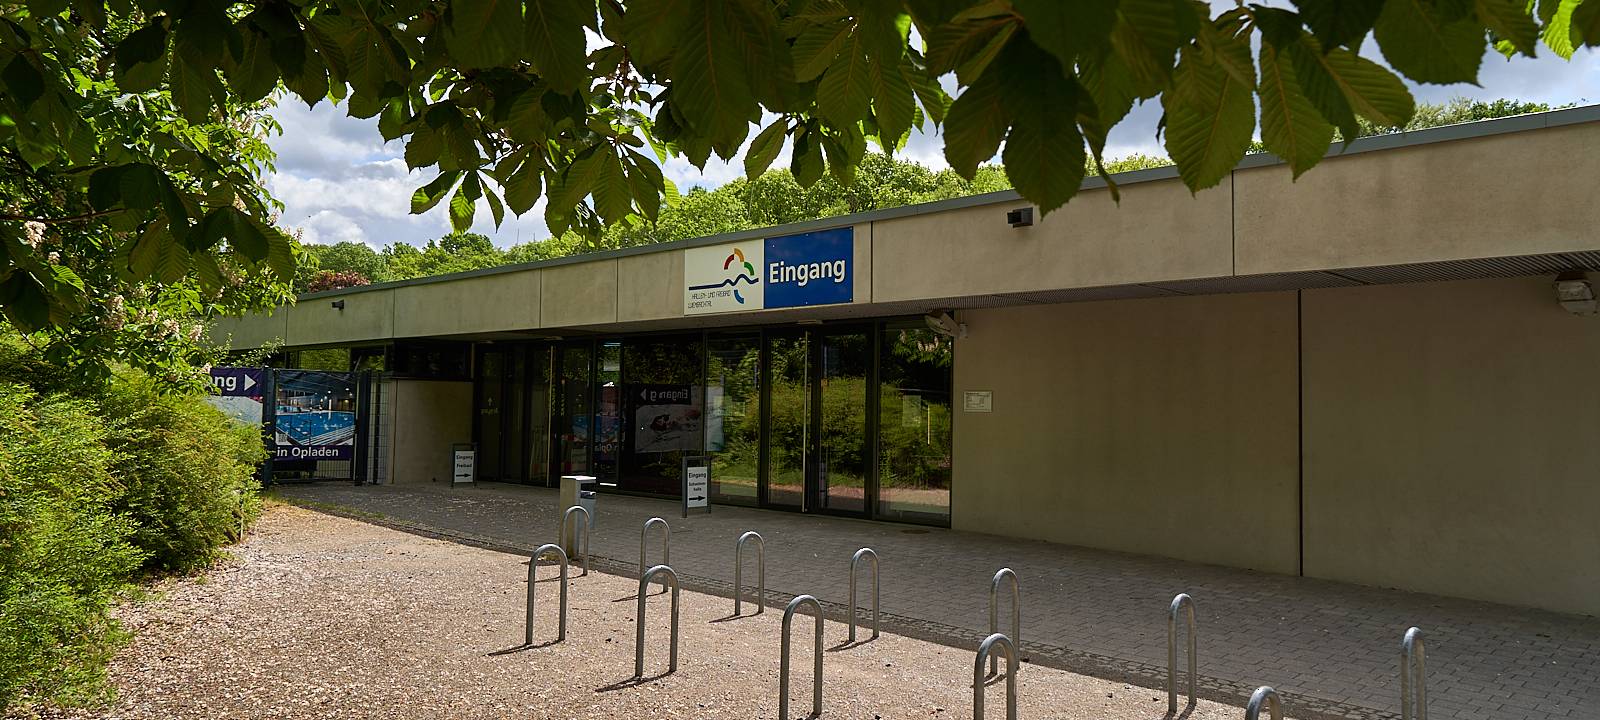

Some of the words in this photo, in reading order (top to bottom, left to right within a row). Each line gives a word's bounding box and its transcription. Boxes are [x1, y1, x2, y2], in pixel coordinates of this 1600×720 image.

[769, 260, 846, 287] Eingang
[213, 376, 237, 392] ng
[276, 446, 288, 457] in
[291, 446, 339, 459] Opladen
